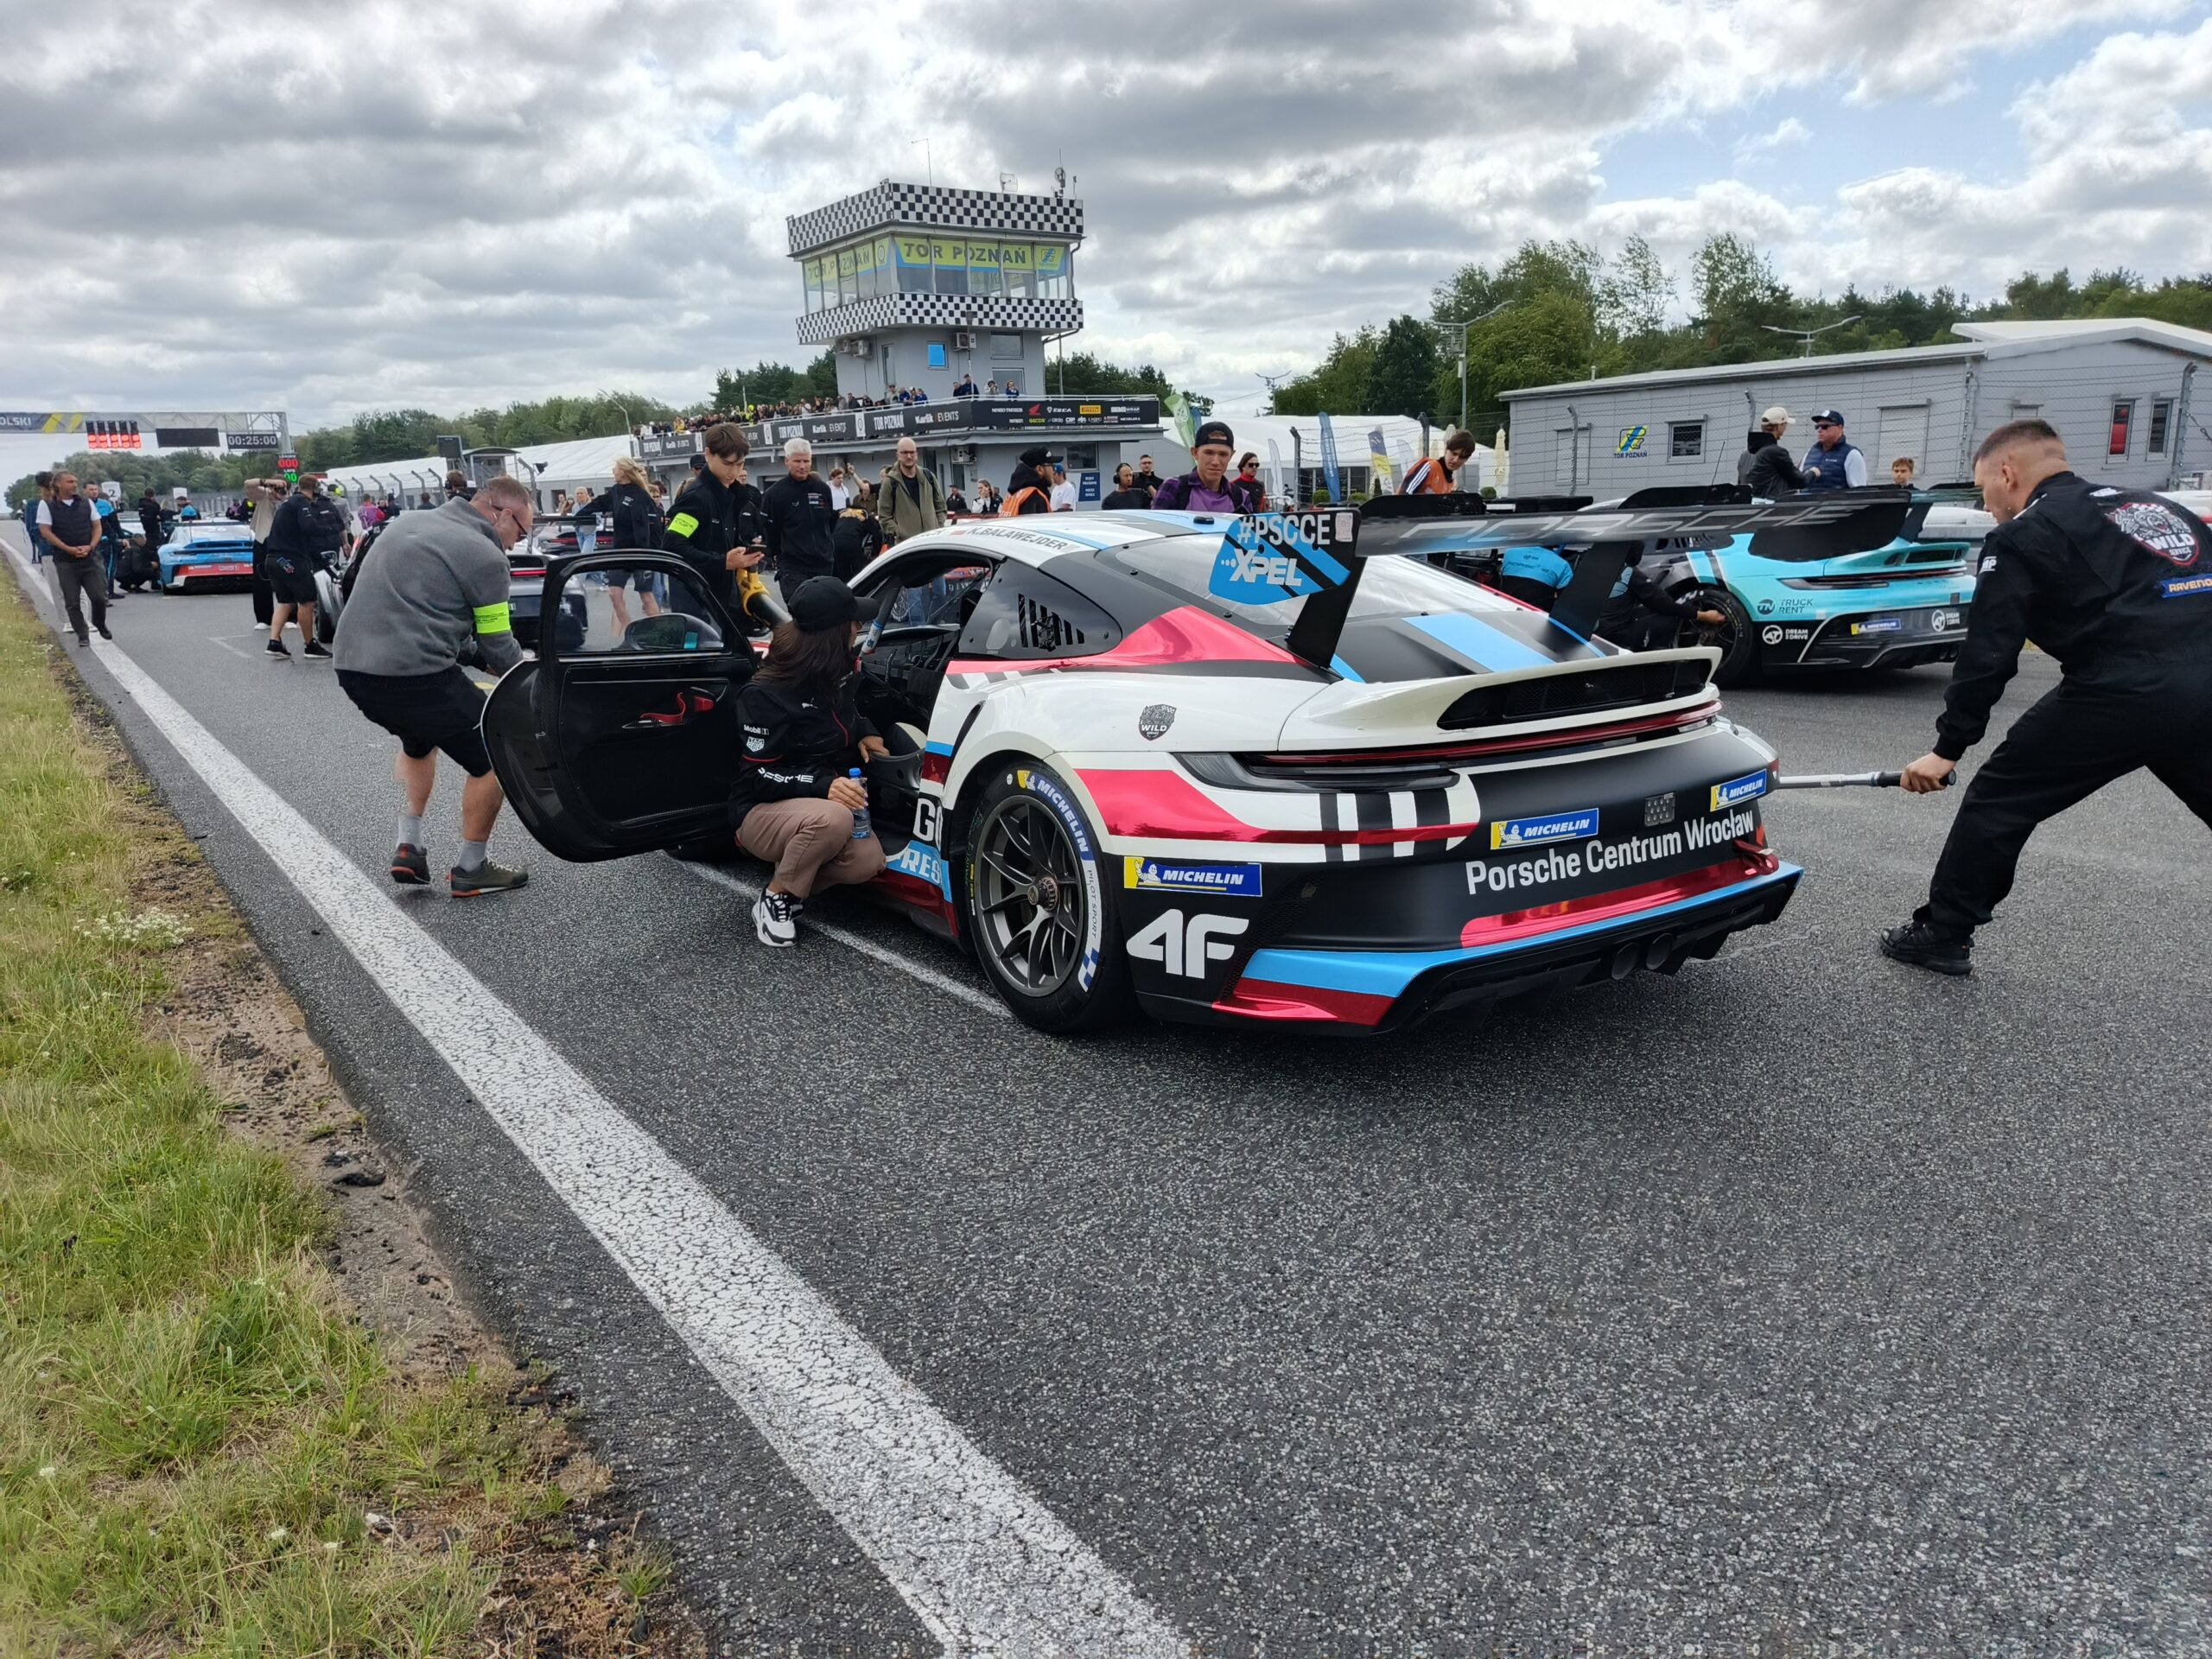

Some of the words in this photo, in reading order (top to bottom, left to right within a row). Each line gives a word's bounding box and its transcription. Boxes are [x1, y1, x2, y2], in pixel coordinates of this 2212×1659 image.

[904, 243, 943, 258] TOR
[953, 247, 1026, 264] POZNAŃ
[874, 416, 884, 430] TOR
[885, 411, 905, 429] POZNAŃ
[938, 411, 959, 422] EVENTS
[228, 435, 276, 445] 00:25:00
[279, 459, 299, 468] 000
[108, 489, 116, 498] 2
[967, 525, 1069, 550] K.BALAWEJDER
[1237, 514, 1331, 545] #PSCCE
[2145, 533, 2196, 550] WILD
[1230, 548, 1302, 587] XPEL
[1780, 598, 1814, 607] TRUCK
[744, 724, 761, 734] Mobil
[1728, 779, 1764, 798] MICHELIN
[1037, 779, 1089, 852] MICHELIN
[1523, 818, 1590, 837] MICHELIN
[1465, 849, 1581, 894] Porsche
[1586, 830, 1681, 871] Centrum
[1684, 808, 1754, 850] Wrocław
[1087, 869, 1096, 900] PILOT
[1162, 869, 1244, 885] MICHELIN
[1126, 908, 1249, 979] 4F
